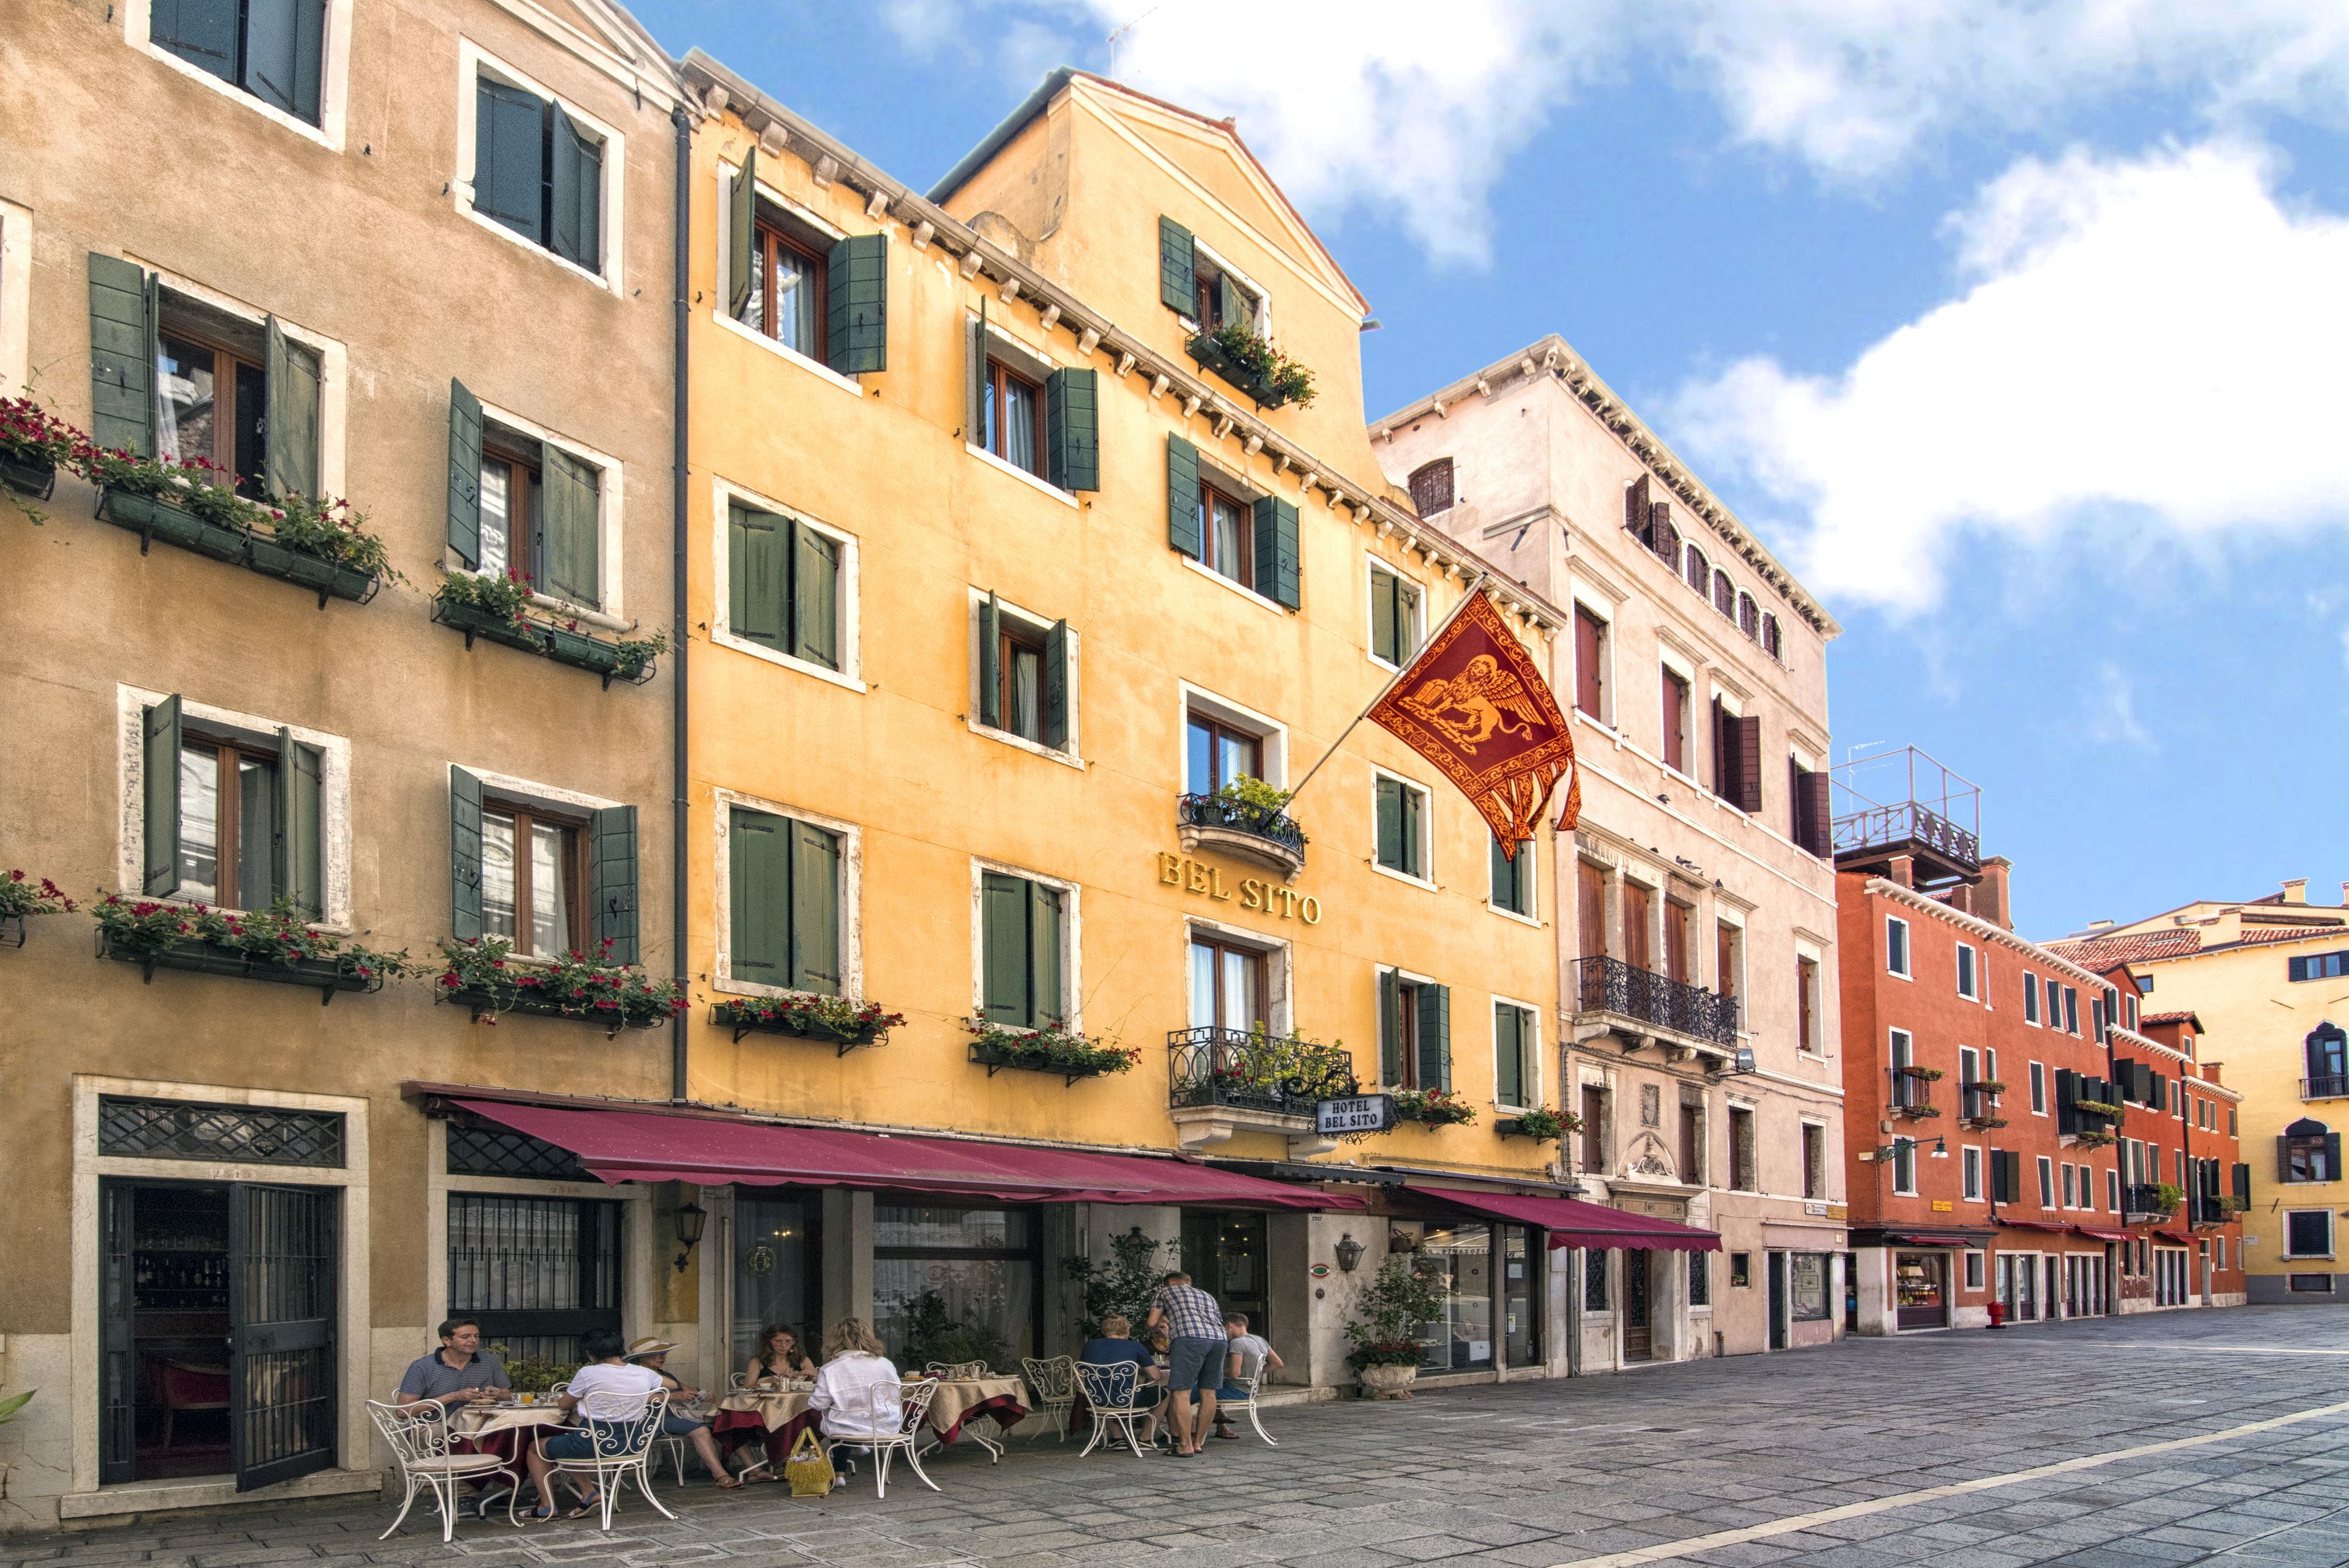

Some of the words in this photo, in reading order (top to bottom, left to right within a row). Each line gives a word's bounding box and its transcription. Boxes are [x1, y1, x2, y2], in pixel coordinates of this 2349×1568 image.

[1158, 851, 1231, 901] BEL
[1241, 879, 1321, 924] SITO
[1332, 1100, 1370, 1113] HOTEL
[1325, 1116, 1346, 1128] BEL
[1350, 1113, 1377, 1126] SITO
